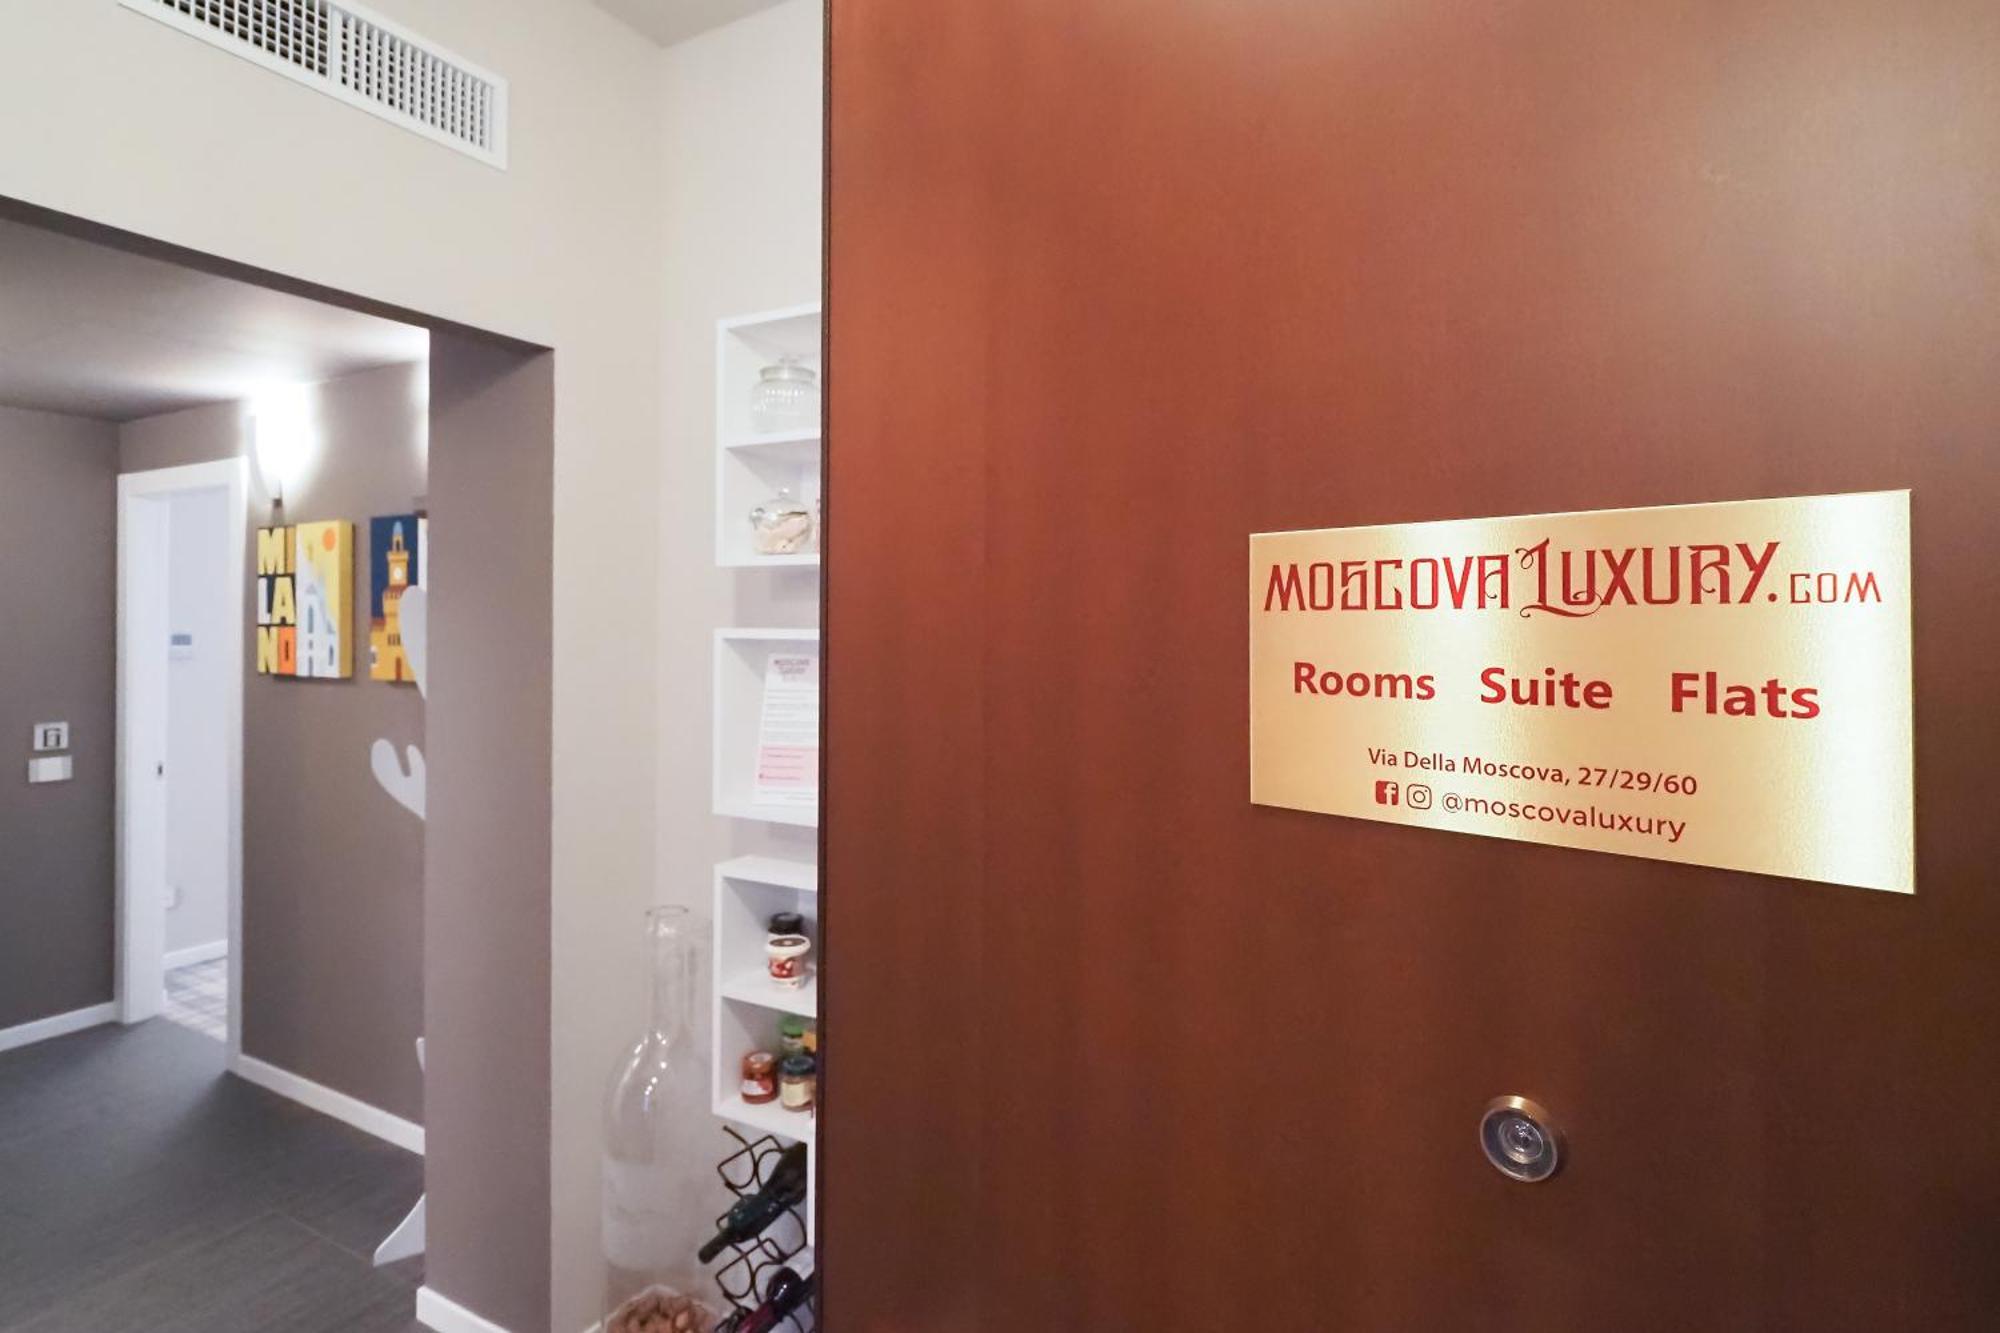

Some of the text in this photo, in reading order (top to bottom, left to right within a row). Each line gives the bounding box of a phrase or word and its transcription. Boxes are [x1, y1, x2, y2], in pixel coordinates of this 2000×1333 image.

[1293, 661, 1821, 720] Rooms Suite Flats
[1368, 747, 1698, 796] Via Della Moscova, 27/29/60
[1441, 792, 1688, 843] @moscovaluxury
